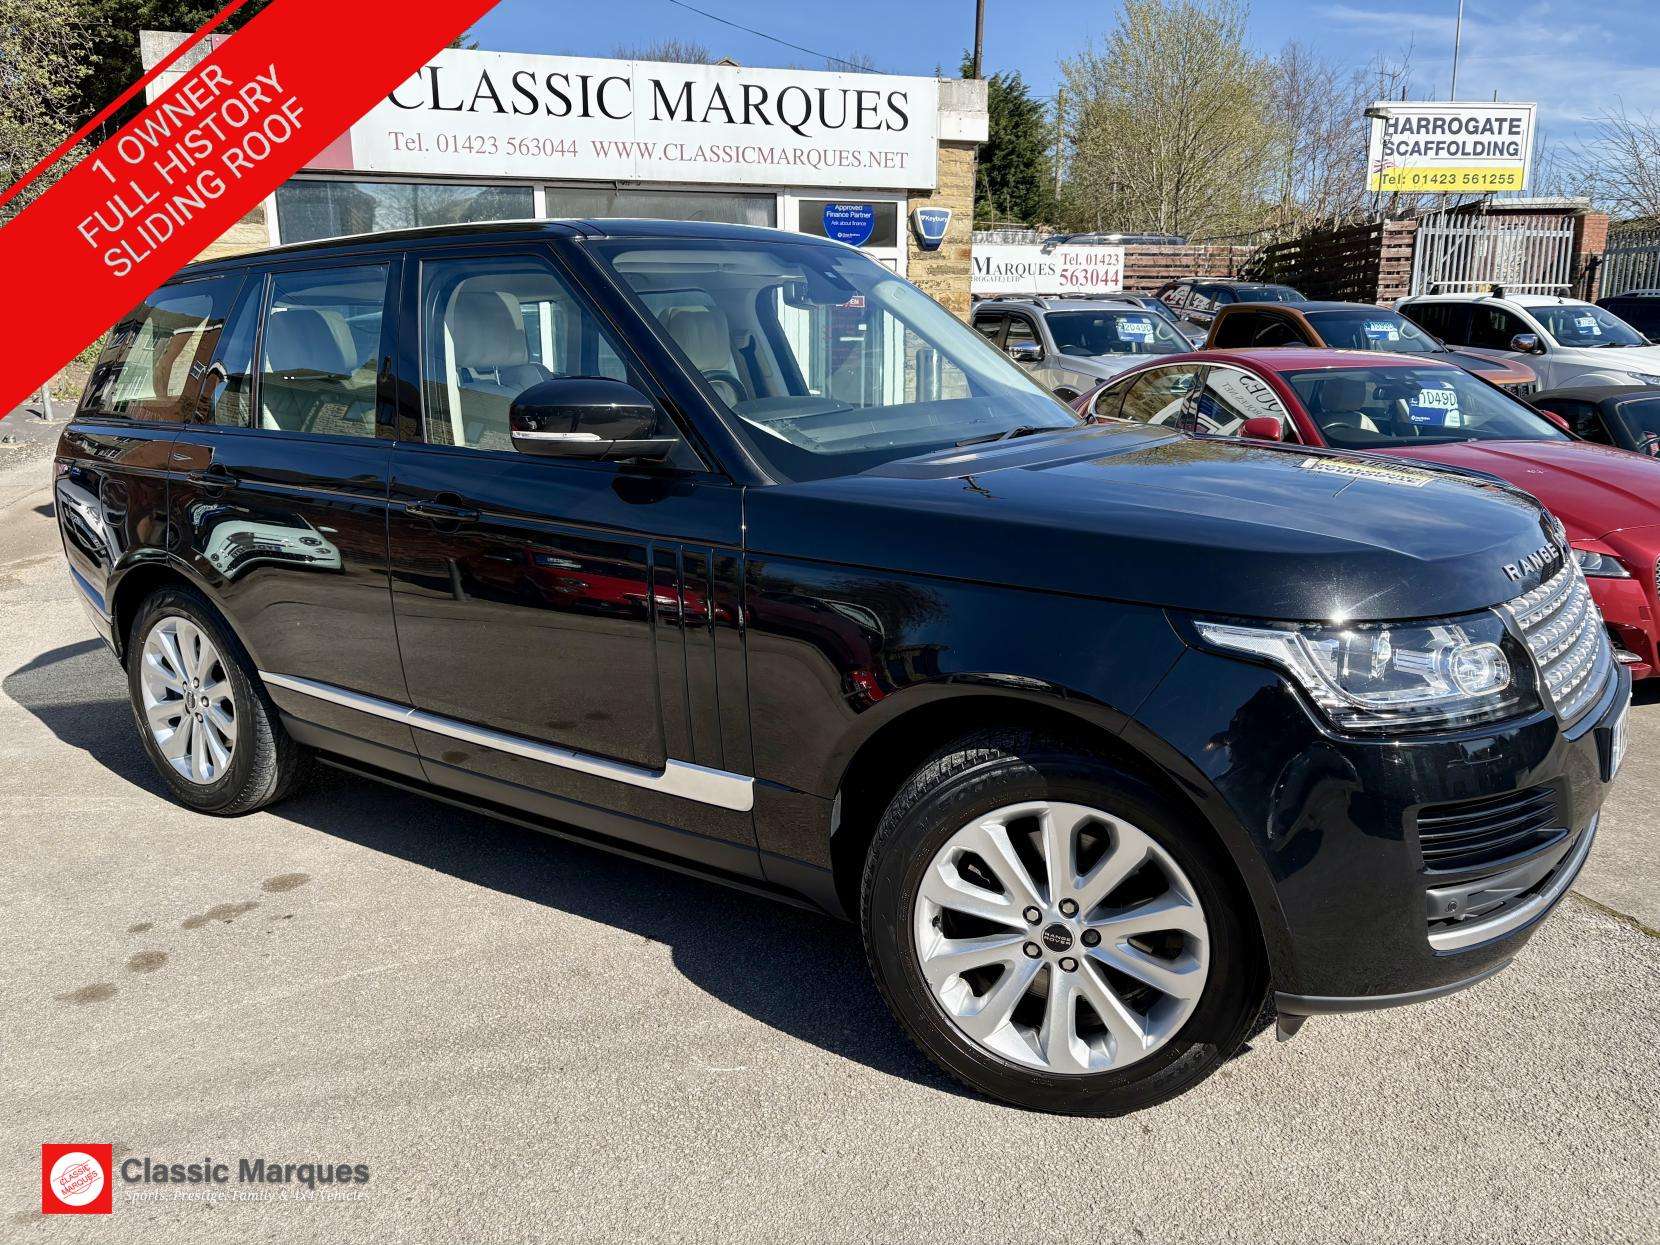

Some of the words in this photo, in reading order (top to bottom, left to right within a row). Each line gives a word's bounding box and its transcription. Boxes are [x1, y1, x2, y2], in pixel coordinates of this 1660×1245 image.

[649, 78, 908, 137] MARQUES
[1387, 116, 1522, 135] HARROGATE
[388, 131, 429, 151] Tel.
[436, 133, 498, 154] 01423
[506, 136, 578, 158] 563044
[592, 140, 908, 170] WWW.CLASSICMARQUES.NET
[1384, 140, 1519, 156] SCAFFOLDING
[1382, 174, 1405, 185] Tel:
[1412, 174, 1456, 184] 01423
[1462, 174, 1515, 184] 561255
[1061, 253, 1081, 265] Tel.
[1086, 253, 1119, 266] 01423
[1059, 268, 1119, 286] 563044
[1420, 391, 1457, 406] 10490
[1502, 542, 1560, 582] RANGE
